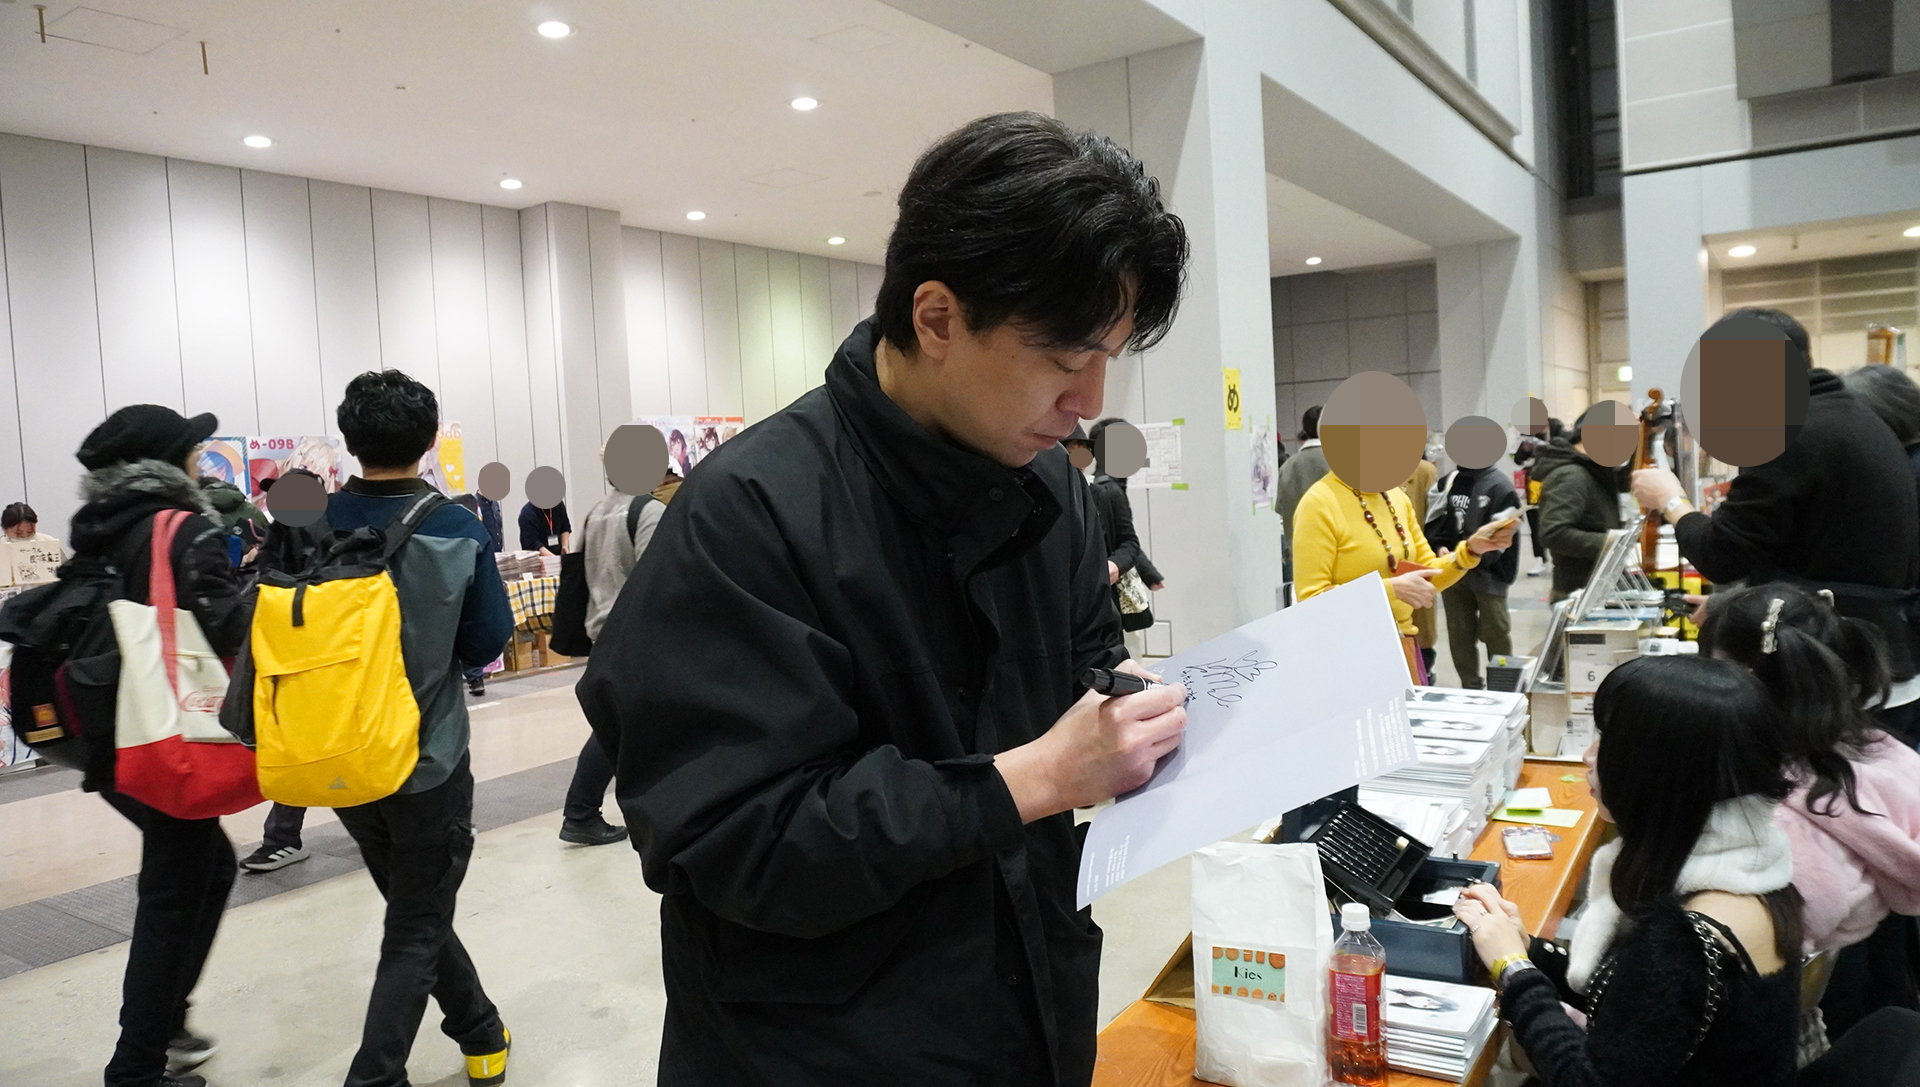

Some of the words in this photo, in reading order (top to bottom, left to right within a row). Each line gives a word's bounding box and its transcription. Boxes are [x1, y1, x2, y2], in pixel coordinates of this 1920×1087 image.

[1227, 384, 1240, 413] め
[249, 438, 294, 450] め-09B
[1587, 670, 1596, 682] 6
[1234, 966, 1262, 981] Kies
